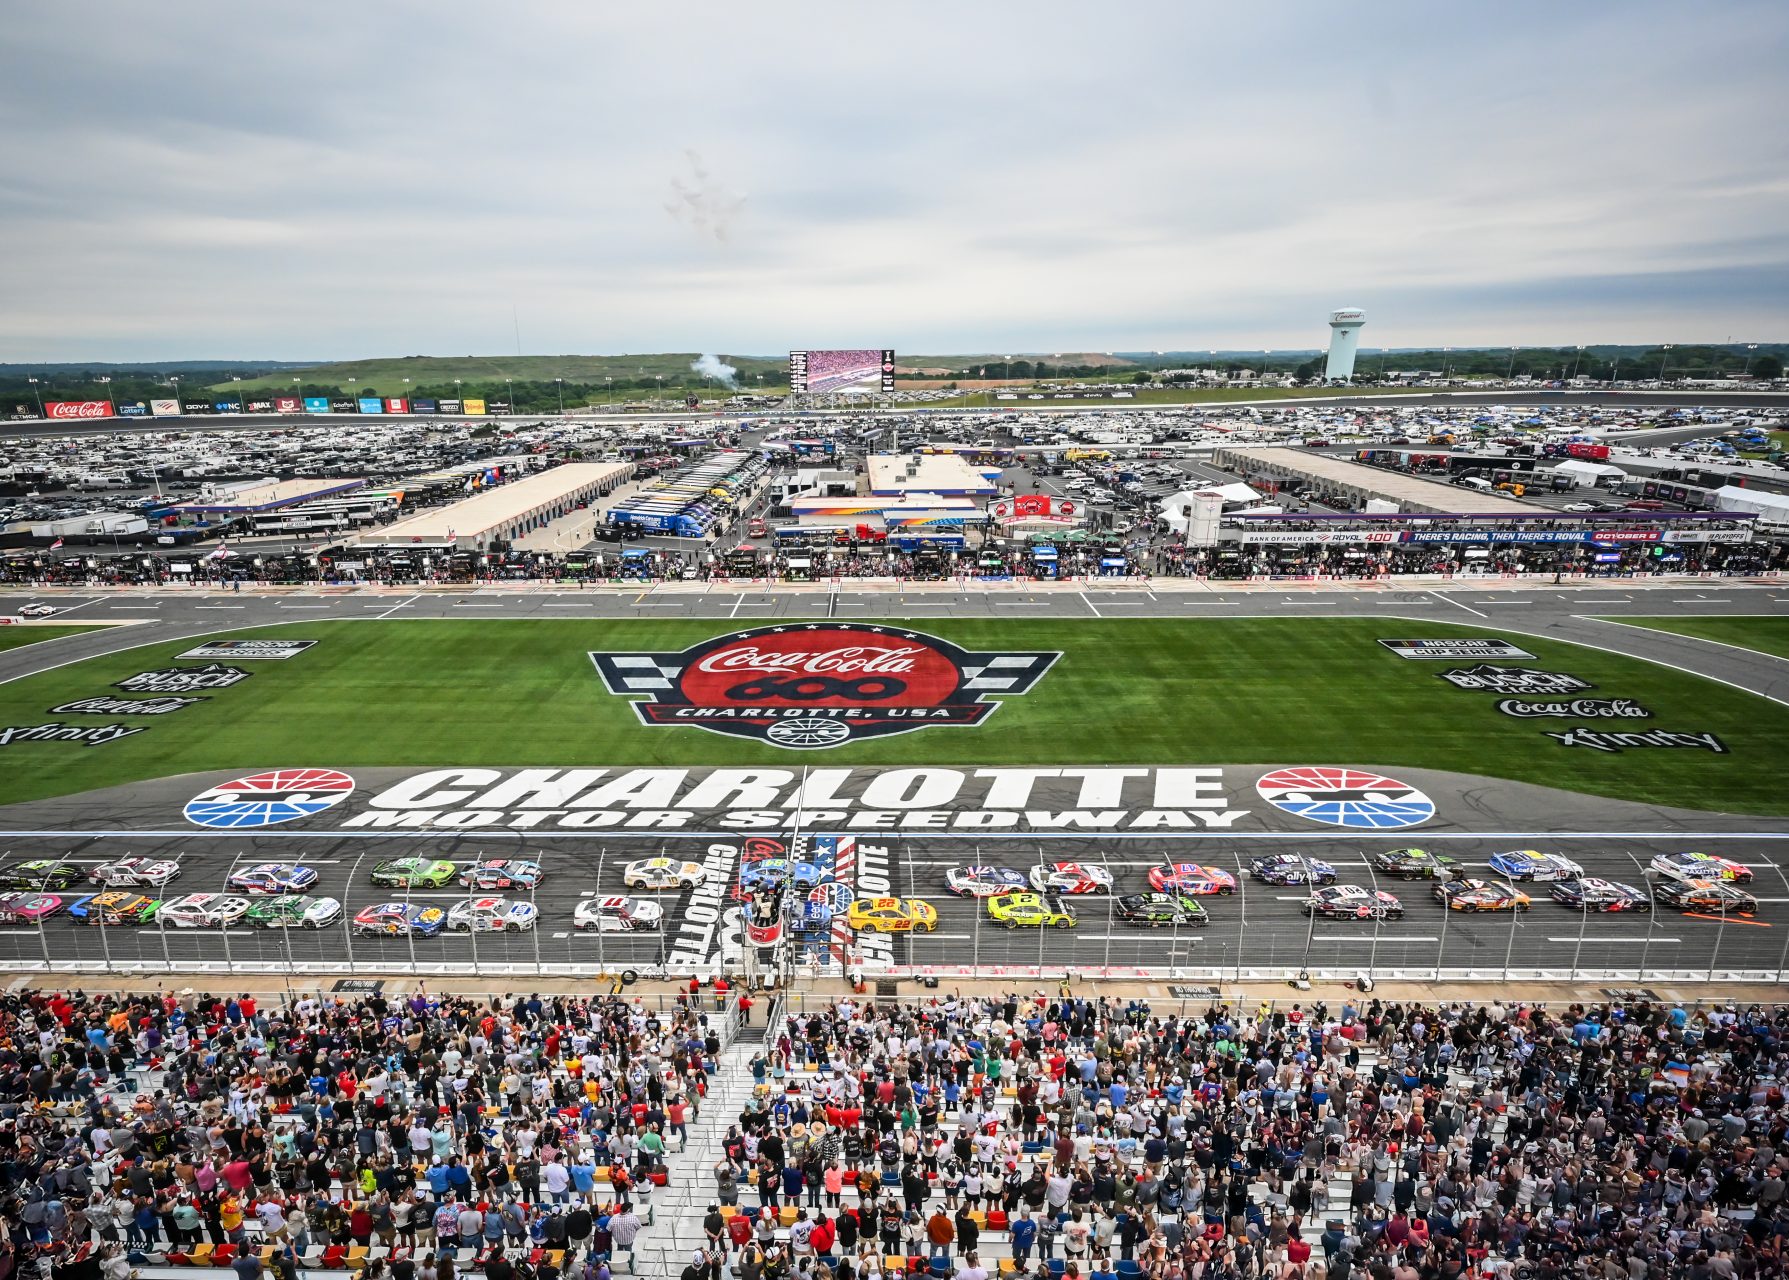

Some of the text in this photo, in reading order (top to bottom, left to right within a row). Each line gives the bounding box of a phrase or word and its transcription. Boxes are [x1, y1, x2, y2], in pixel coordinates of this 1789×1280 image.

[53, 402, 106, 418] Coca-Cola
[608, 513, 616, 522] 5
[1364, 533, 1393, 542] 400
[1414, 533, 1450, 541] THERE'S
[1452, 533, 1489, 541] RACING,
[1491, 532, 1515, 541] THEN
[1517, 532, 1553, 540] THERE'S
[1654, 547, 1663, 556] 9
[1422, 640, 1490, 648] NASCAR
[699, 646, 927, 674] Coca-Cola
[118, 671, 250, 687] BUSCH
[1444, 672, 1592, 689] BUSCH
[724, 677, 908, 701] 600
[1494, 685, 1567, 694] LIGHT
[1500, 699, 1648, 717] Coca-Cola
[675, 707, 951, 719] CHARLOTTE, USA
[1545, 727, 1723, 752] xfinity
[368, 768, 1228, 810] CHARLOTTE
[339, 810, 1252, 828] MOTOR SPEEDWAY
[666, 876, 678, 885] 10
[1286, 871, 1306, 882] ally
[264, 881, 277, 890] 99
[1082, 881, 1091, 889] 7
[1202, 883, 1215, 892] 47
[603, 897, 624, 906] 11
[877, 898, 896, 908] 22
[1020, 894, 1033, 903] 2
[1617, 898, 1633, 908] 42
[791, 920, 804, 929] 21
[894, 920, 911, 929] 22
